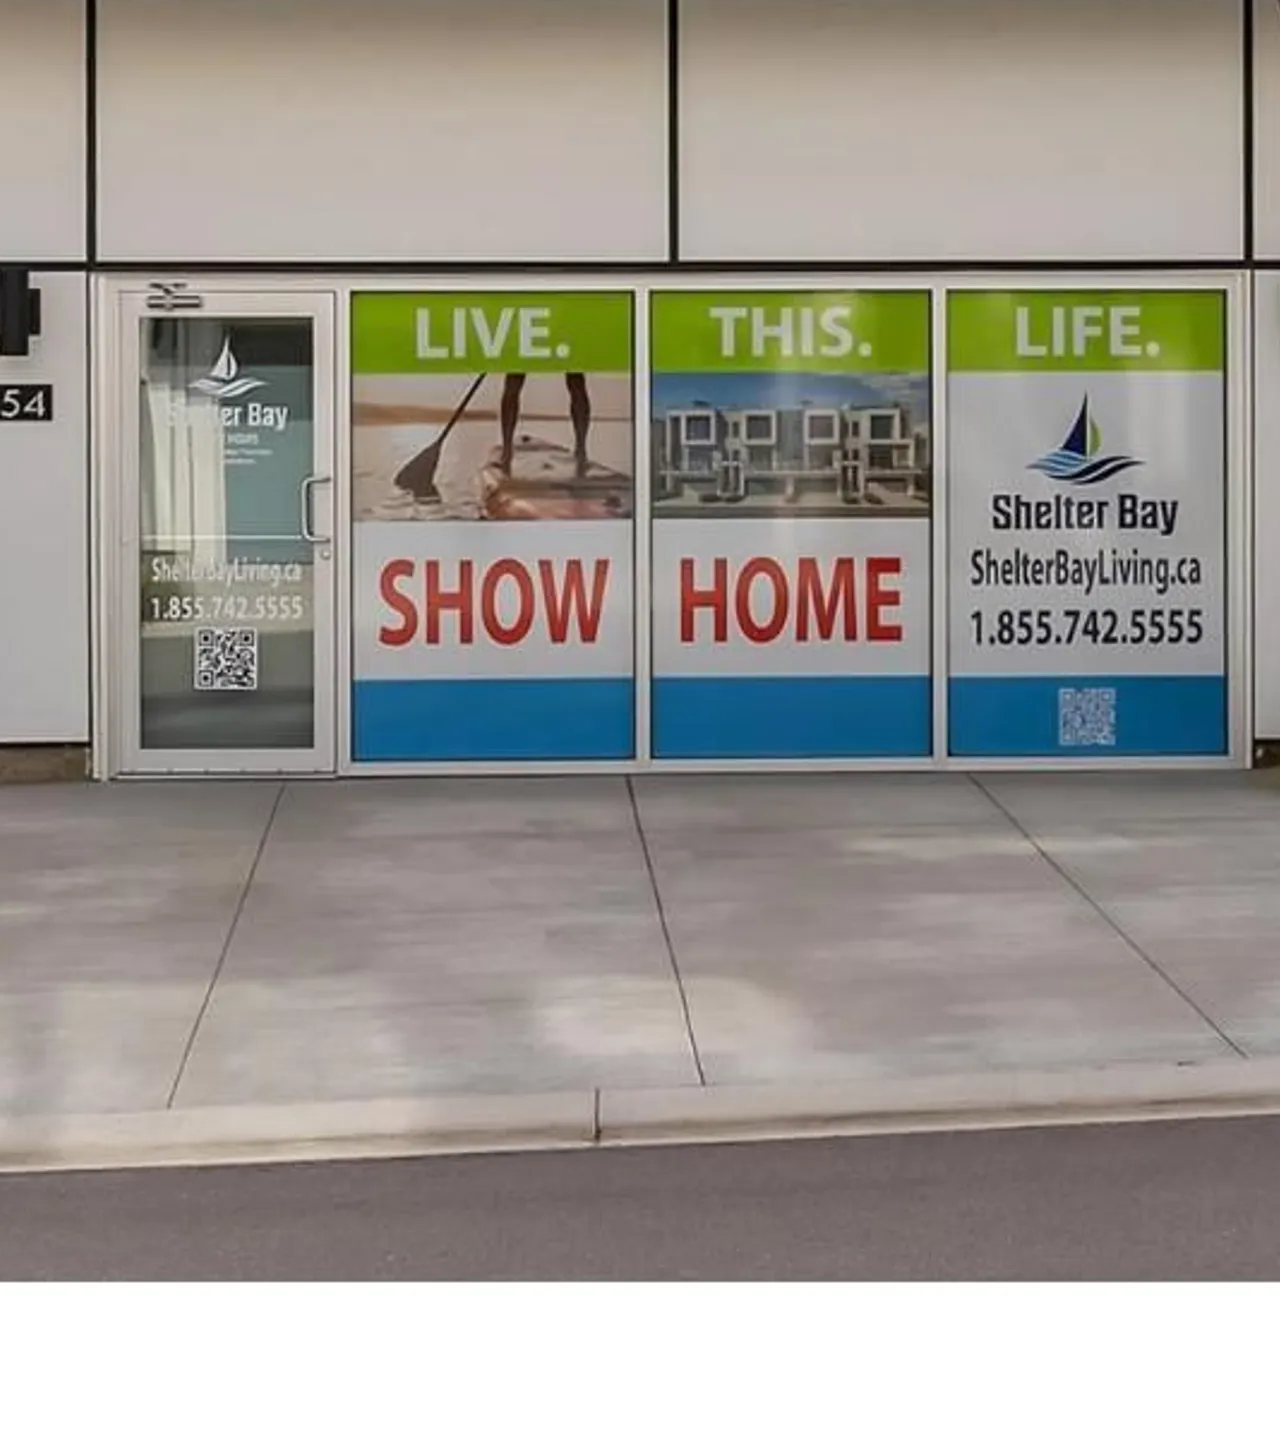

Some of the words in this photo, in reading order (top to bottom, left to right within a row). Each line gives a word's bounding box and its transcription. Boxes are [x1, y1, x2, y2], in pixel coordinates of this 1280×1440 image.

[415, 306, 570, 358] LIVE.
[710, 306, 872, 358] THIS.
[1016, 306, 1160, 357] LIFE.
[247, 402, 288, 431] Bay
[992, 494, 1108, 531] Shelter
[1118, 494, 1178, 536] Bay
[970, 549, 1202, 595] ShelterBayLiving.ca
[150, 594, 304, 620] 1.855.742.5555
[378, 558, 610, 646] SHOW
[680, 557, 903, 643] HOME
[970, 610, 1203, 646] 1.855.742.5555
